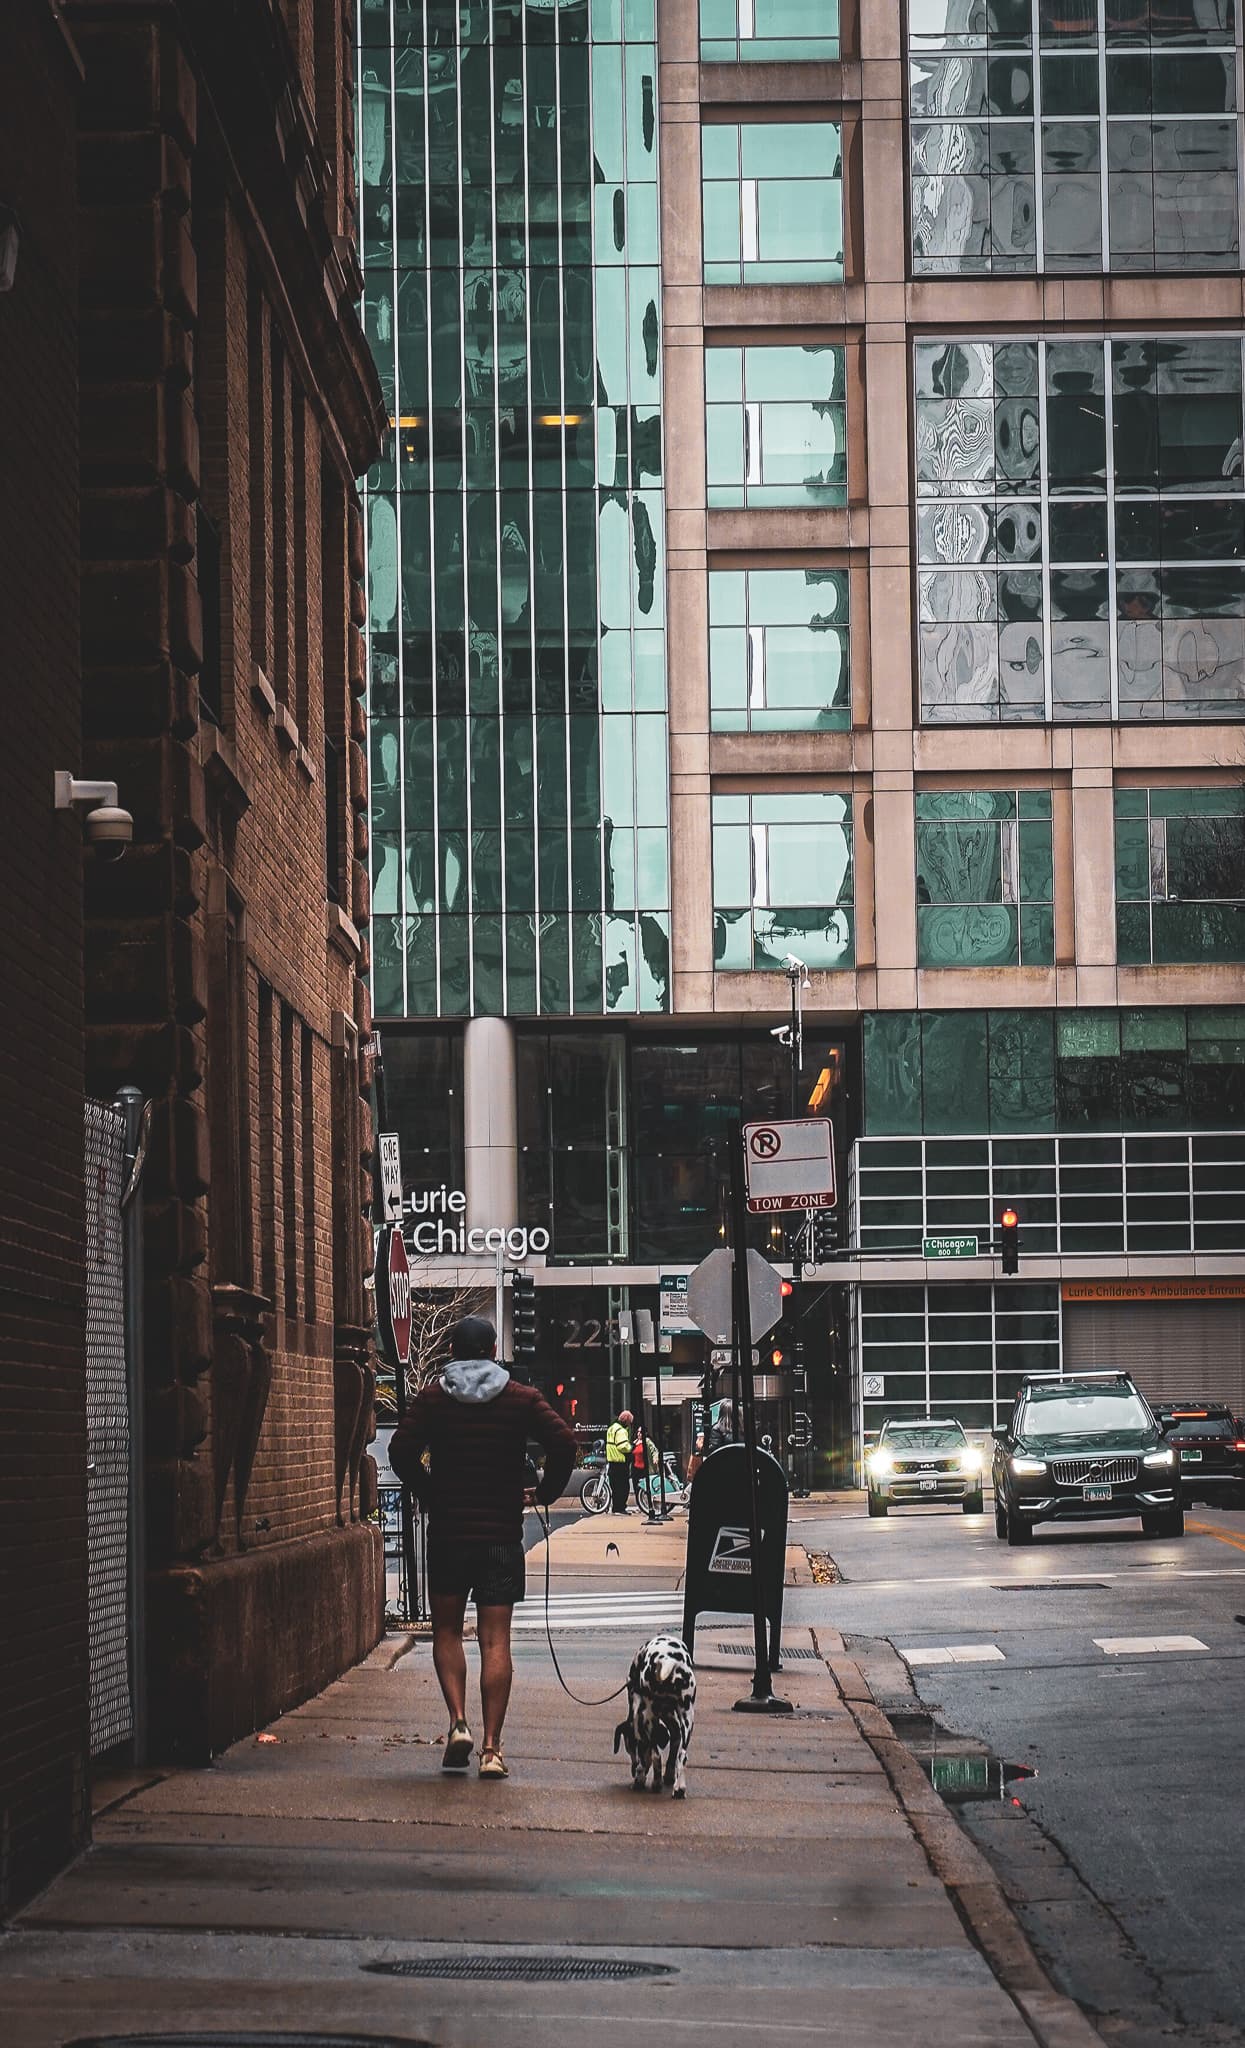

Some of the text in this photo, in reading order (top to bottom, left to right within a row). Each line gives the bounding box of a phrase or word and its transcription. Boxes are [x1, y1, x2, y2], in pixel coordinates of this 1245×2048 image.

[383, 1138, 398, 1161] ONE
[383, 1166, 399, 1186] WAY
[754, 1194, 828, 1210] TOW ZONE
[413, 1219, 550, 1261] Chicago
[931, 1239, 965, 1250] Chicago
[966, 1239, 974, 1247] Av
[390, 1271, 409, 1320] STOP
[1068, 1286, 1093, 1297] Lurie
[1096, 1286, 1146, 1297] Children's
[1150, 1285, 1207, 1297] Ambulance
